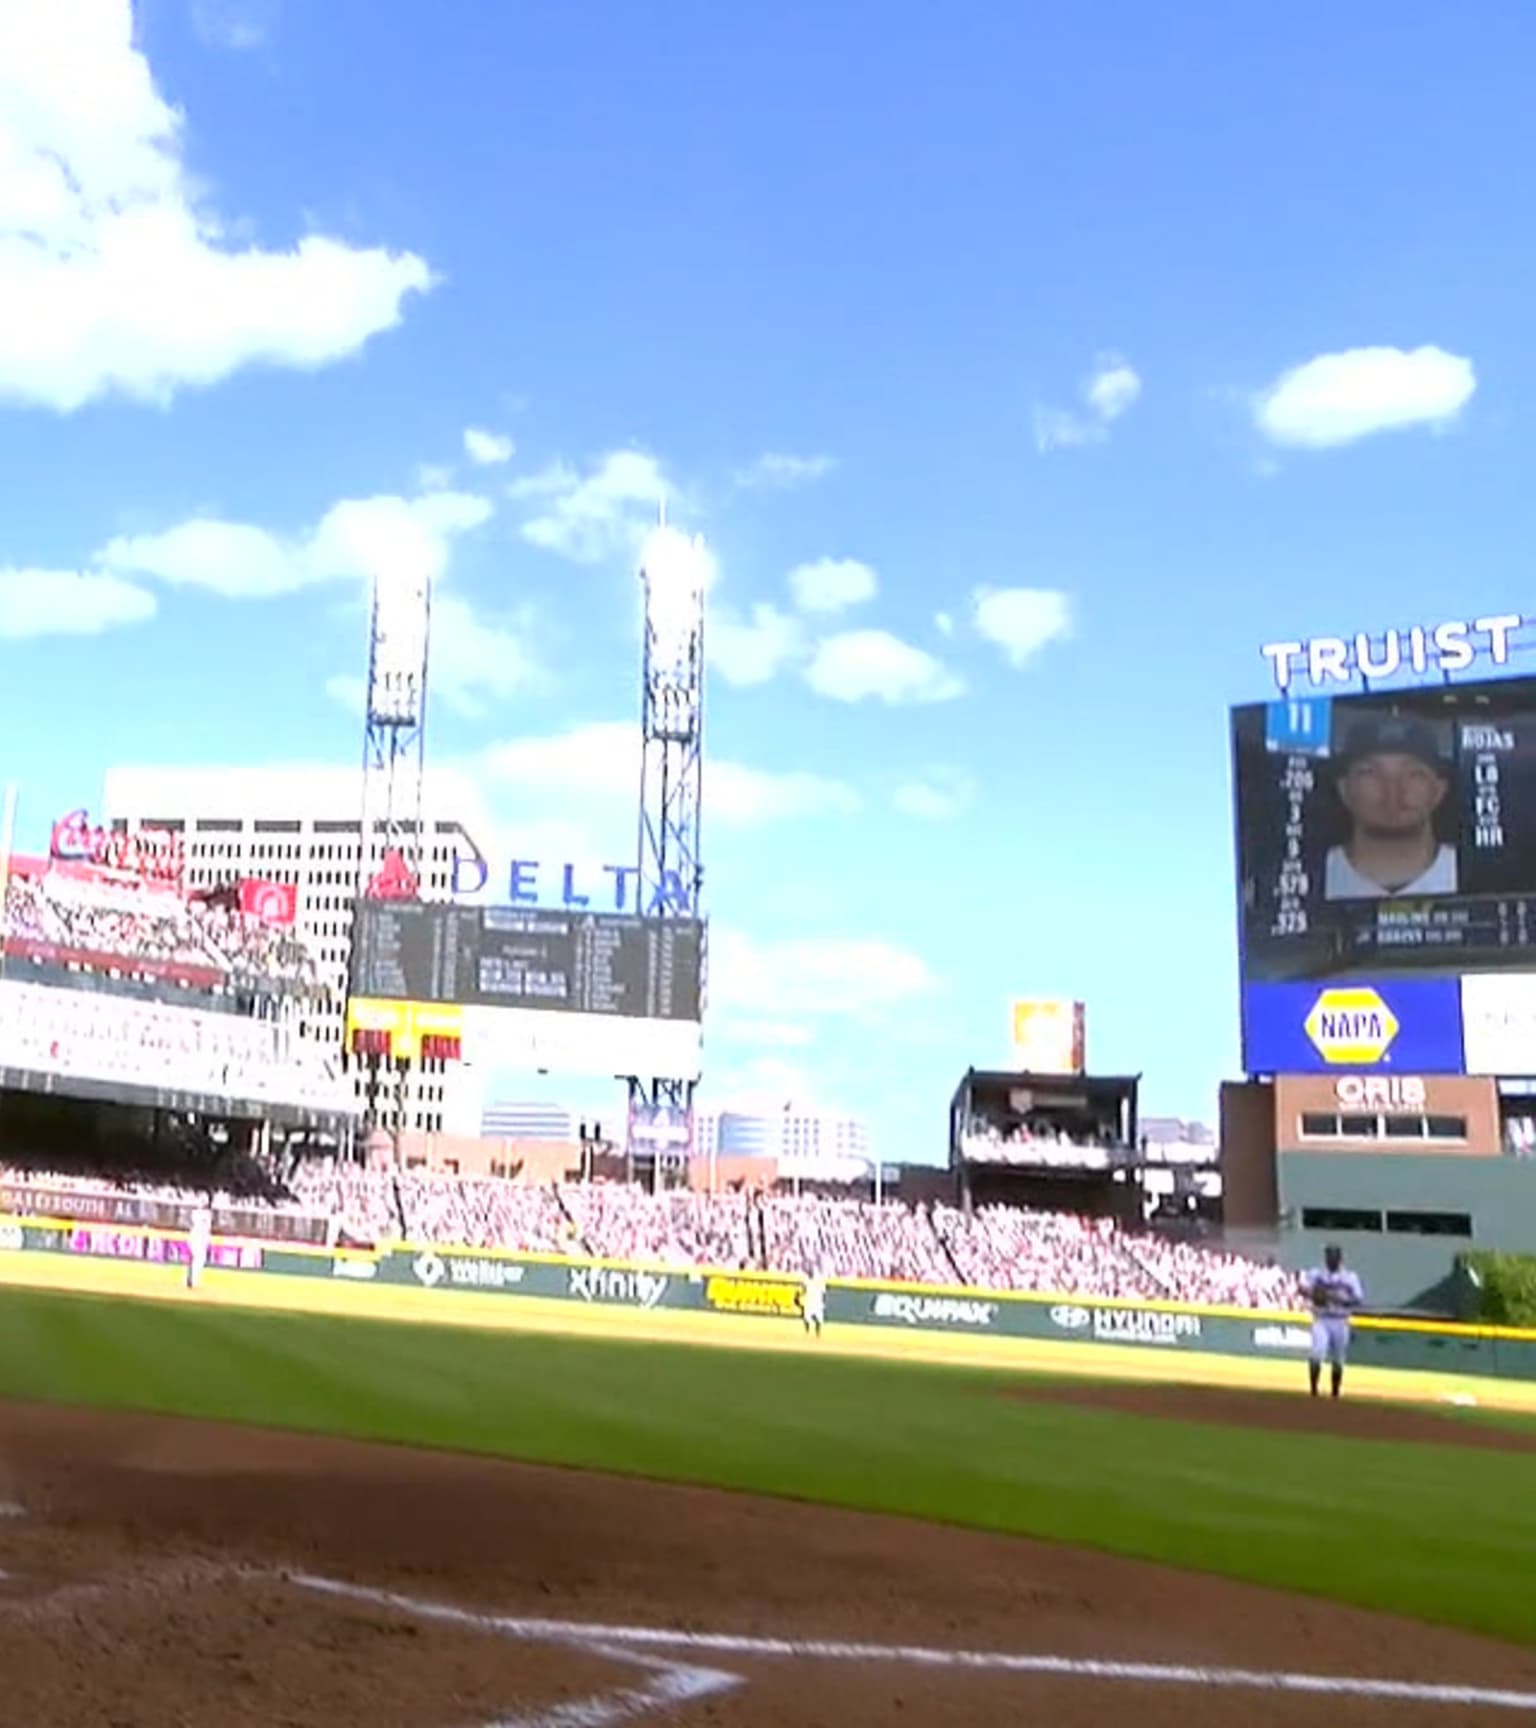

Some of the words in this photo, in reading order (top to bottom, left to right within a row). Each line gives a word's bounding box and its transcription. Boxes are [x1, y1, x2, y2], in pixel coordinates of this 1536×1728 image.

[1260, 614, 1521, 690] TRUIST
[451, 855, 692, 914] DELTA
[1321, 1012, 1382, 1039] NAPA
